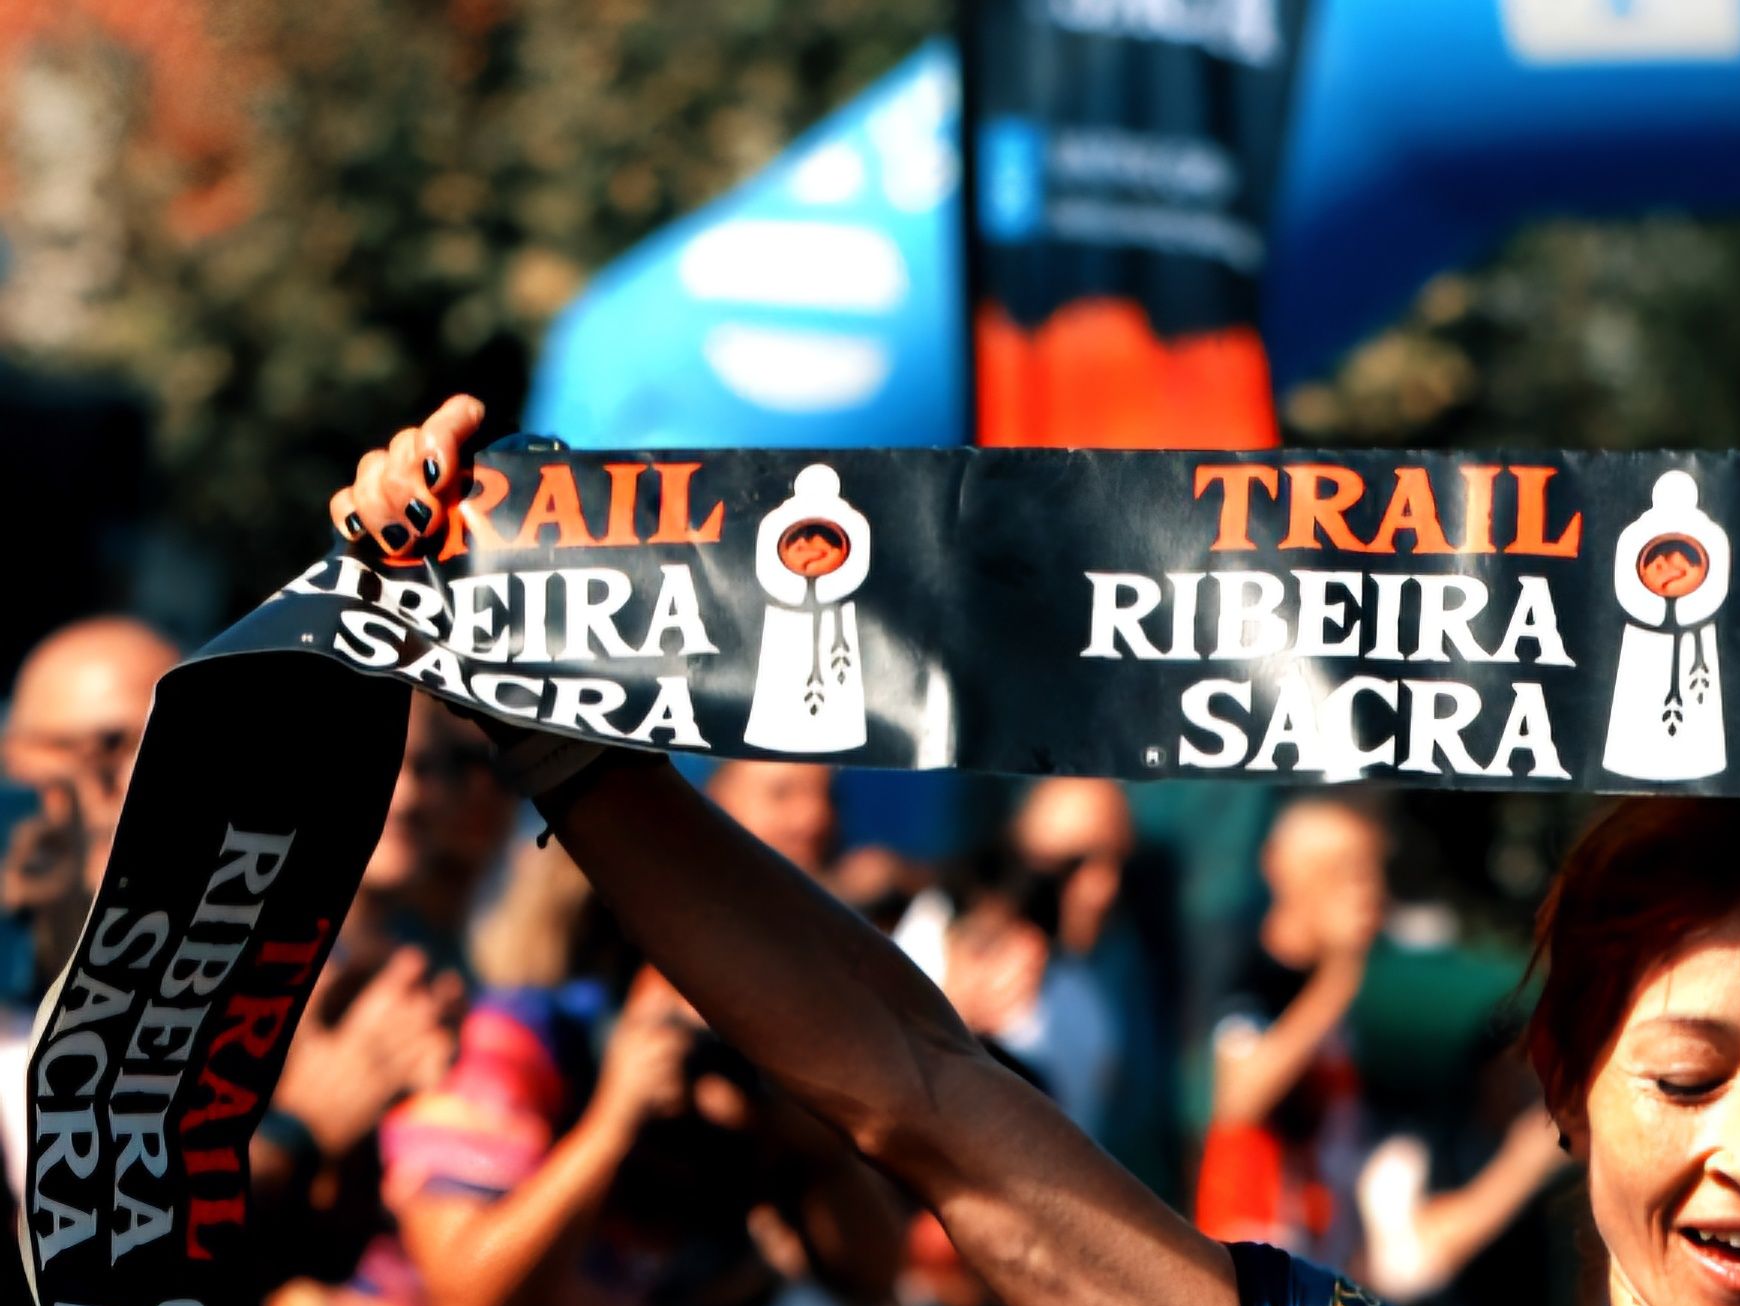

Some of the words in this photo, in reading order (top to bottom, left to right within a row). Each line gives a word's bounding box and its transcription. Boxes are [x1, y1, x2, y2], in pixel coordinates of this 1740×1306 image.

[382, 463, 724, 567] RAIL
[1194, 463, 1582, 558] TRAIL
[334, 610, 712, 748] SACRA
[1081, 570, 1576, 667] RIBEIRA
[1179, 677, 1572, 781] SACRA
[35, 906, 171, 1272] SACRA
[110, 821, 297, 1269] RIBEIRA
[180, 918, 330, 1261] TRAIL
